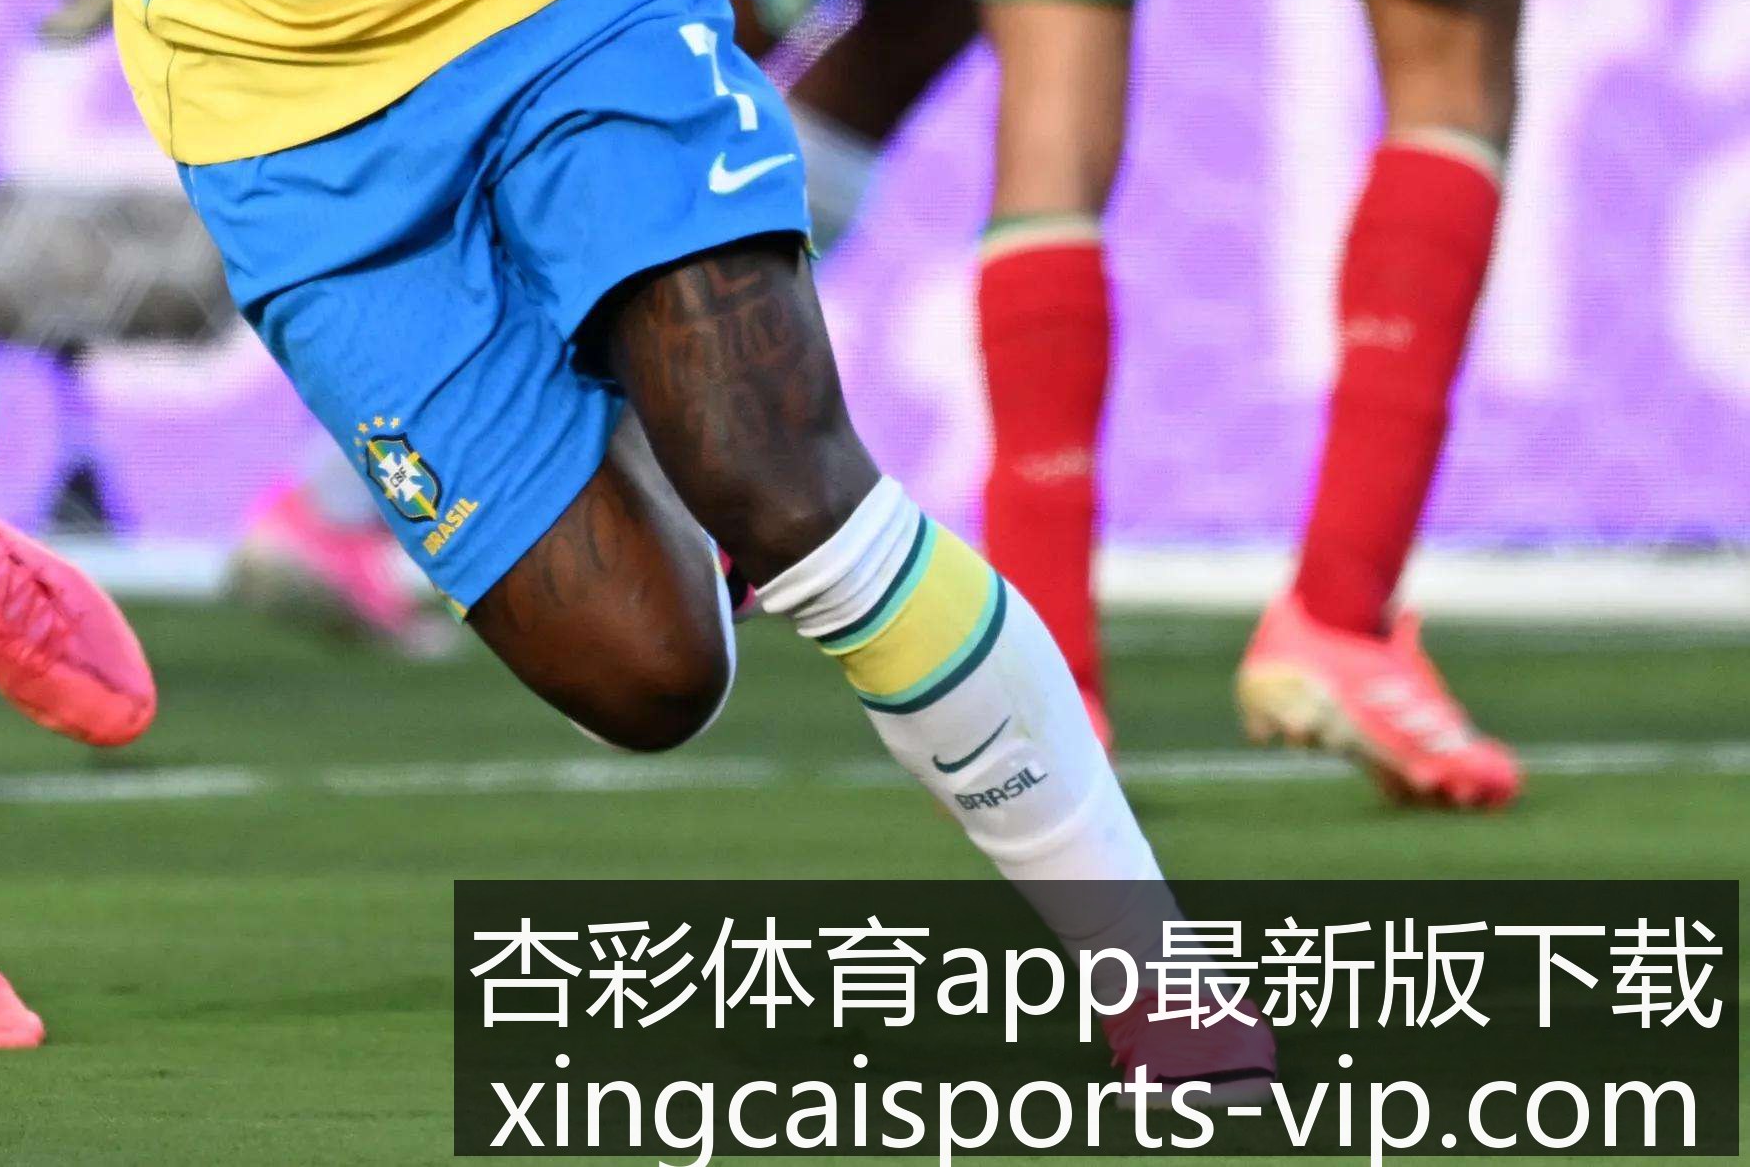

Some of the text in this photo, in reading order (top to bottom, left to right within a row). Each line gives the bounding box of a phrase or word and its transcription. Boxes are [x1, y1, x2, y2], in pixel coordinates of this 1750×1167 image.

[679, 23, 758, 131] 7
[390, 466, 407, 488] CBF
[423, 497, 479, 556] BRASIL
[954, 766, 1048, 811] BRASIL
